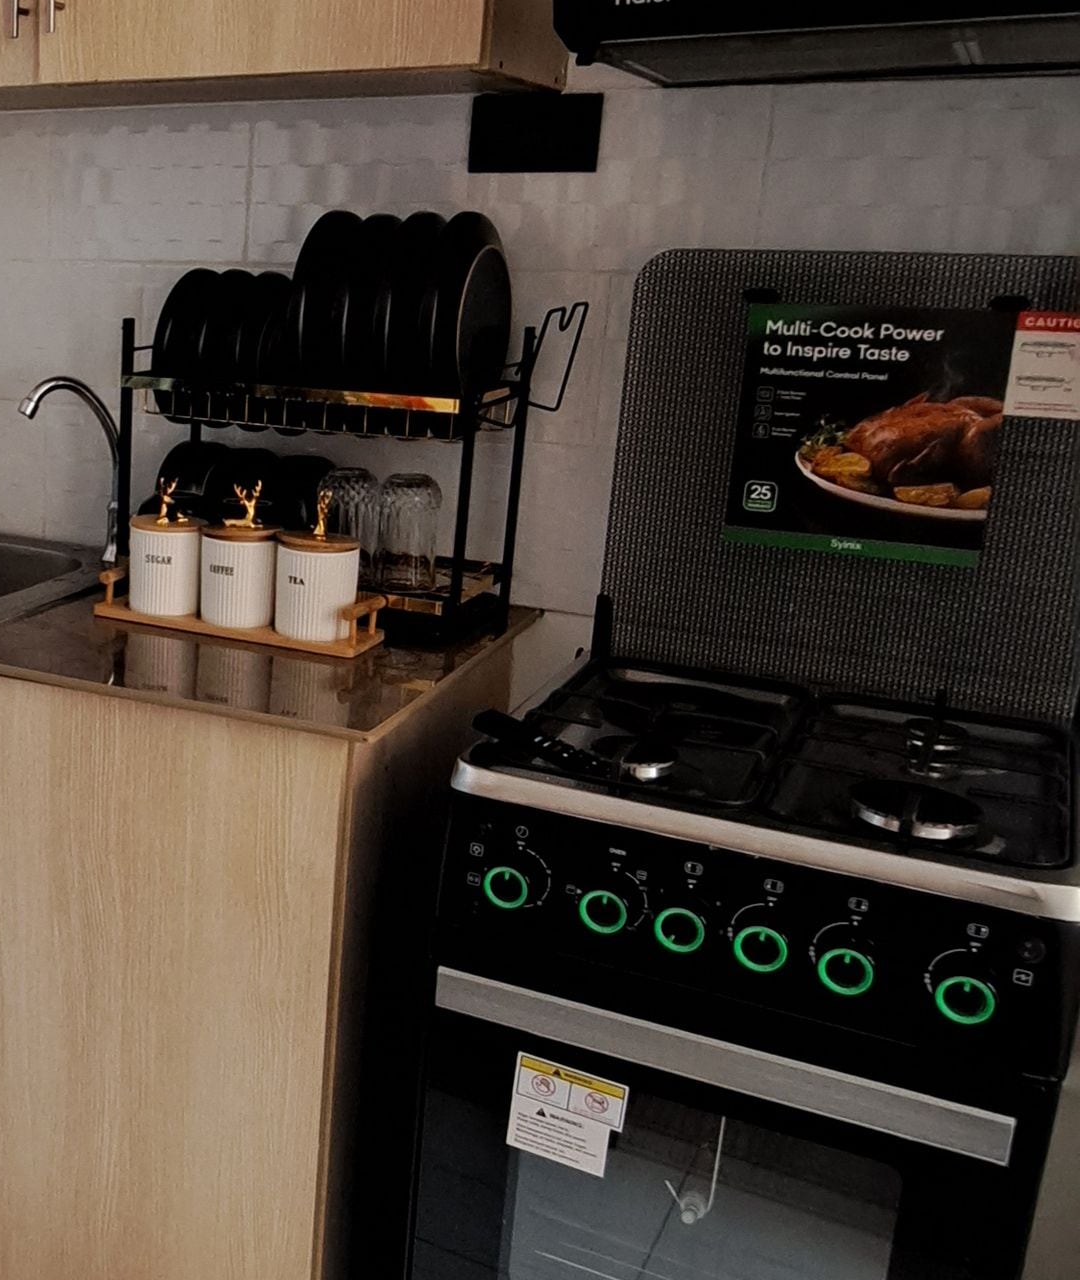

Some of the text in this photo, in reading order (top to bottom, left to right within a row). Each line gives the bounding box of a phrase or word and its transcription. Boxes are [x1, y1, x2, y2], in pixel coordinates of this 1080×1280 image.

[765, 319, 944, 341] Multi-Cook Power
[763, 341, 910, 362] to Inspire Taste
[760, 367, 888, 381] Multifunctional Control Panel
[750, 485, 772, 500] 25
[830, 539, 862, 550] Syinix
[209, 564, 234, 576] COFFEE
[288, 575, 305, 586] TEA
